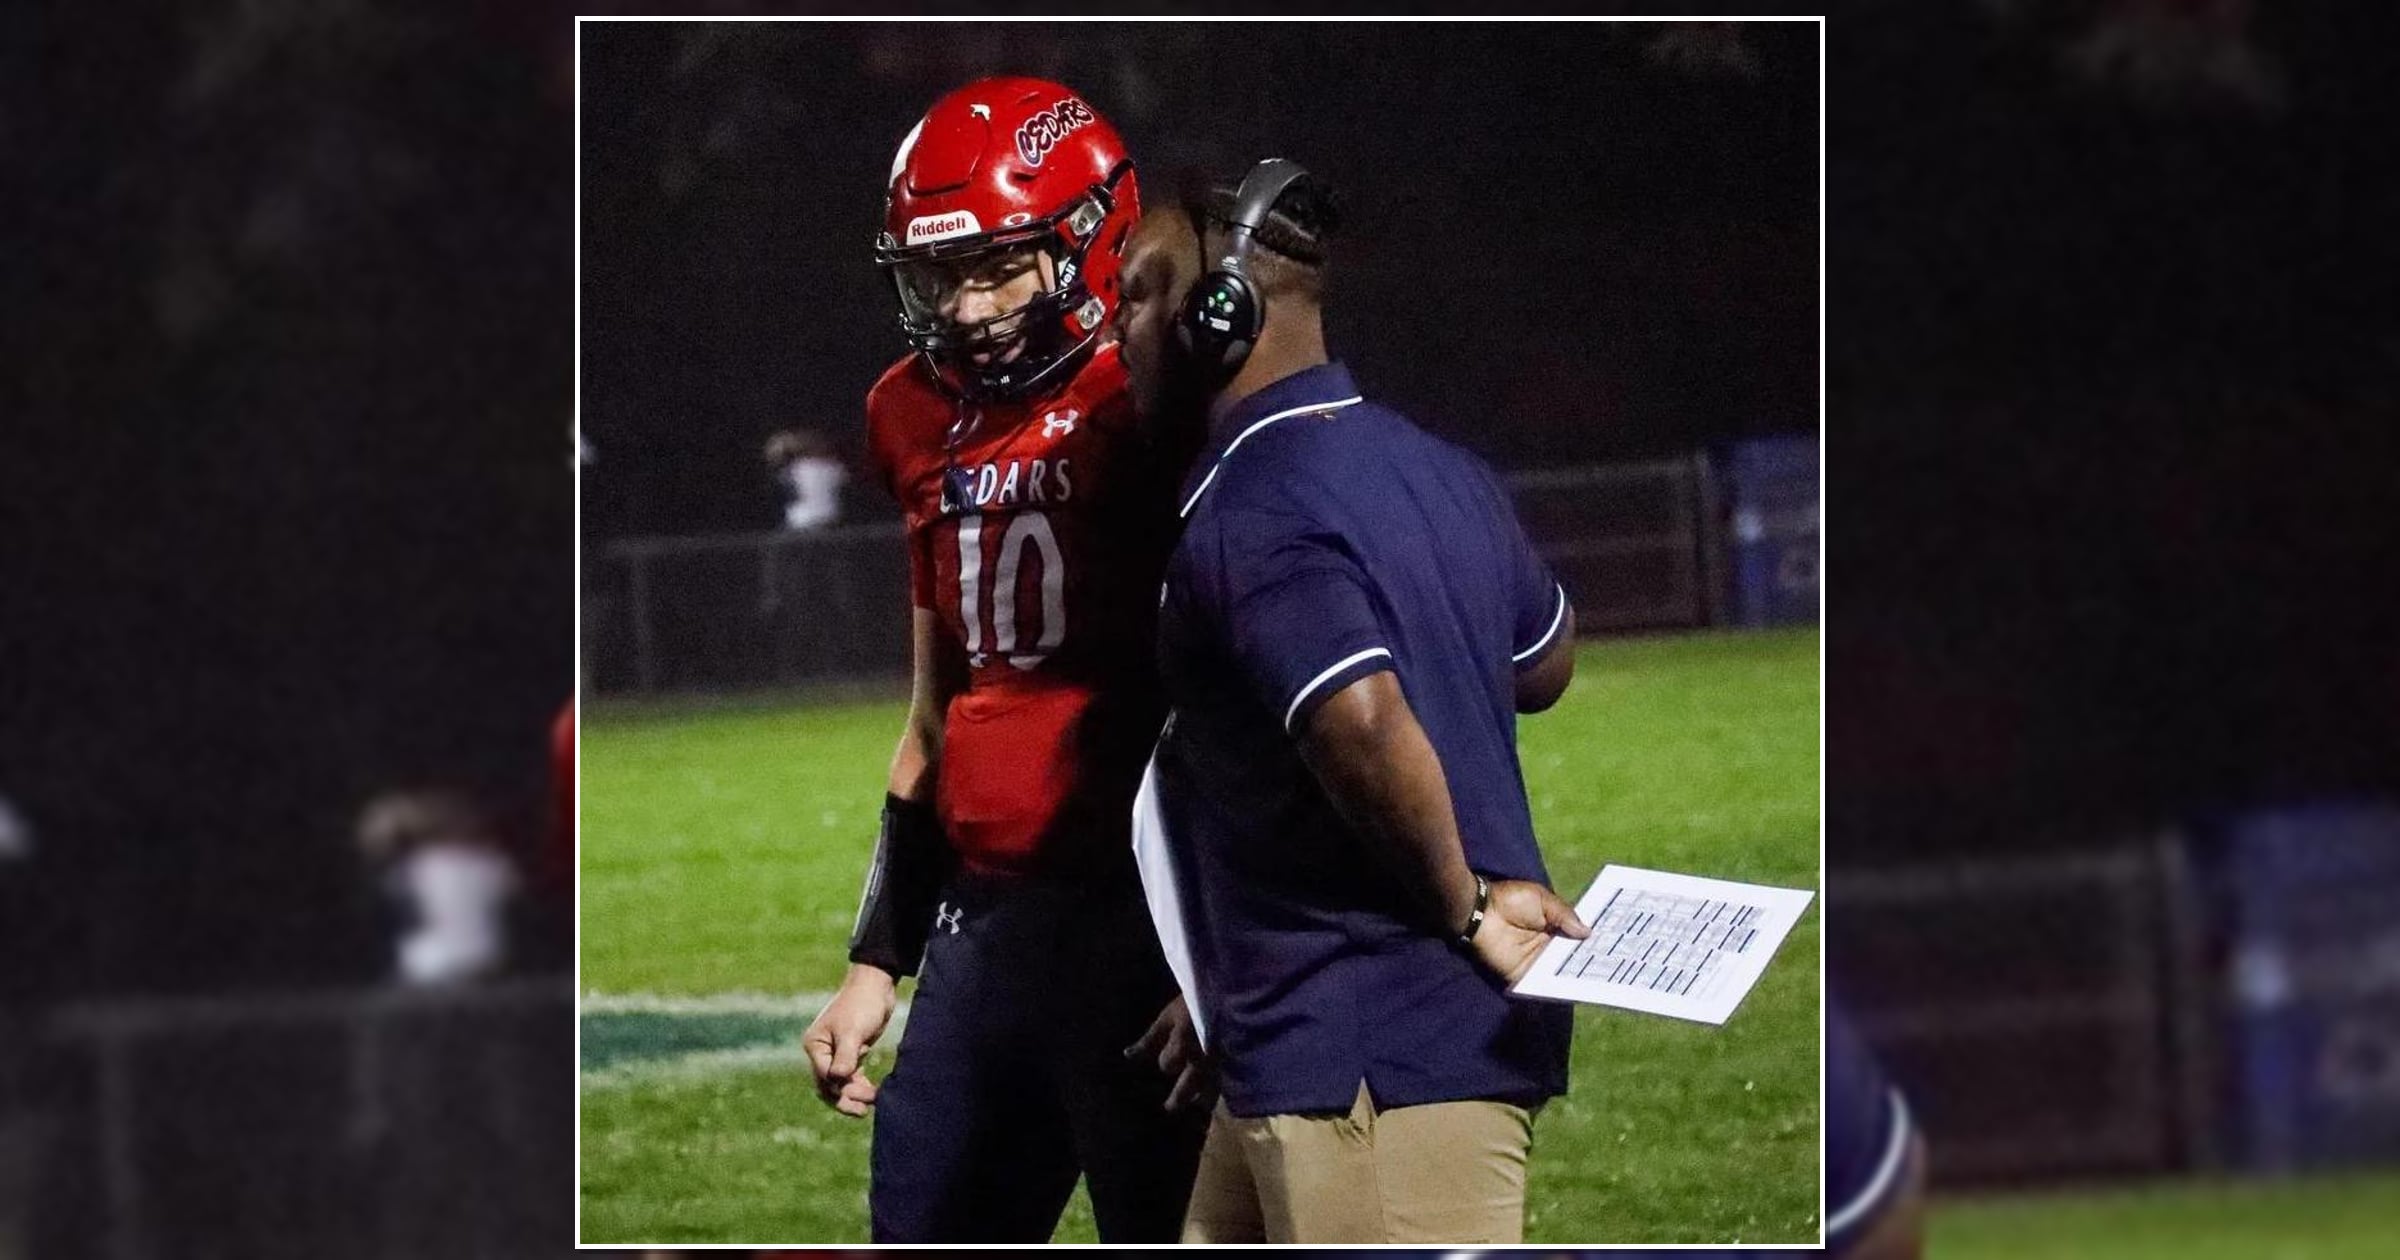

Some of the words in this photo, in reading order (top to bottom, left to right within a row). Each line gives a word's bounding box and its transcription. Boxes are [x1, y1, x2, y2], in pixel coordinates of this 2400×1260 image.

[1015, 97, 1095, 168] CEDARS
[911, 216, 967, 237] Riddell
[957, 511, 1067, 670] 10
